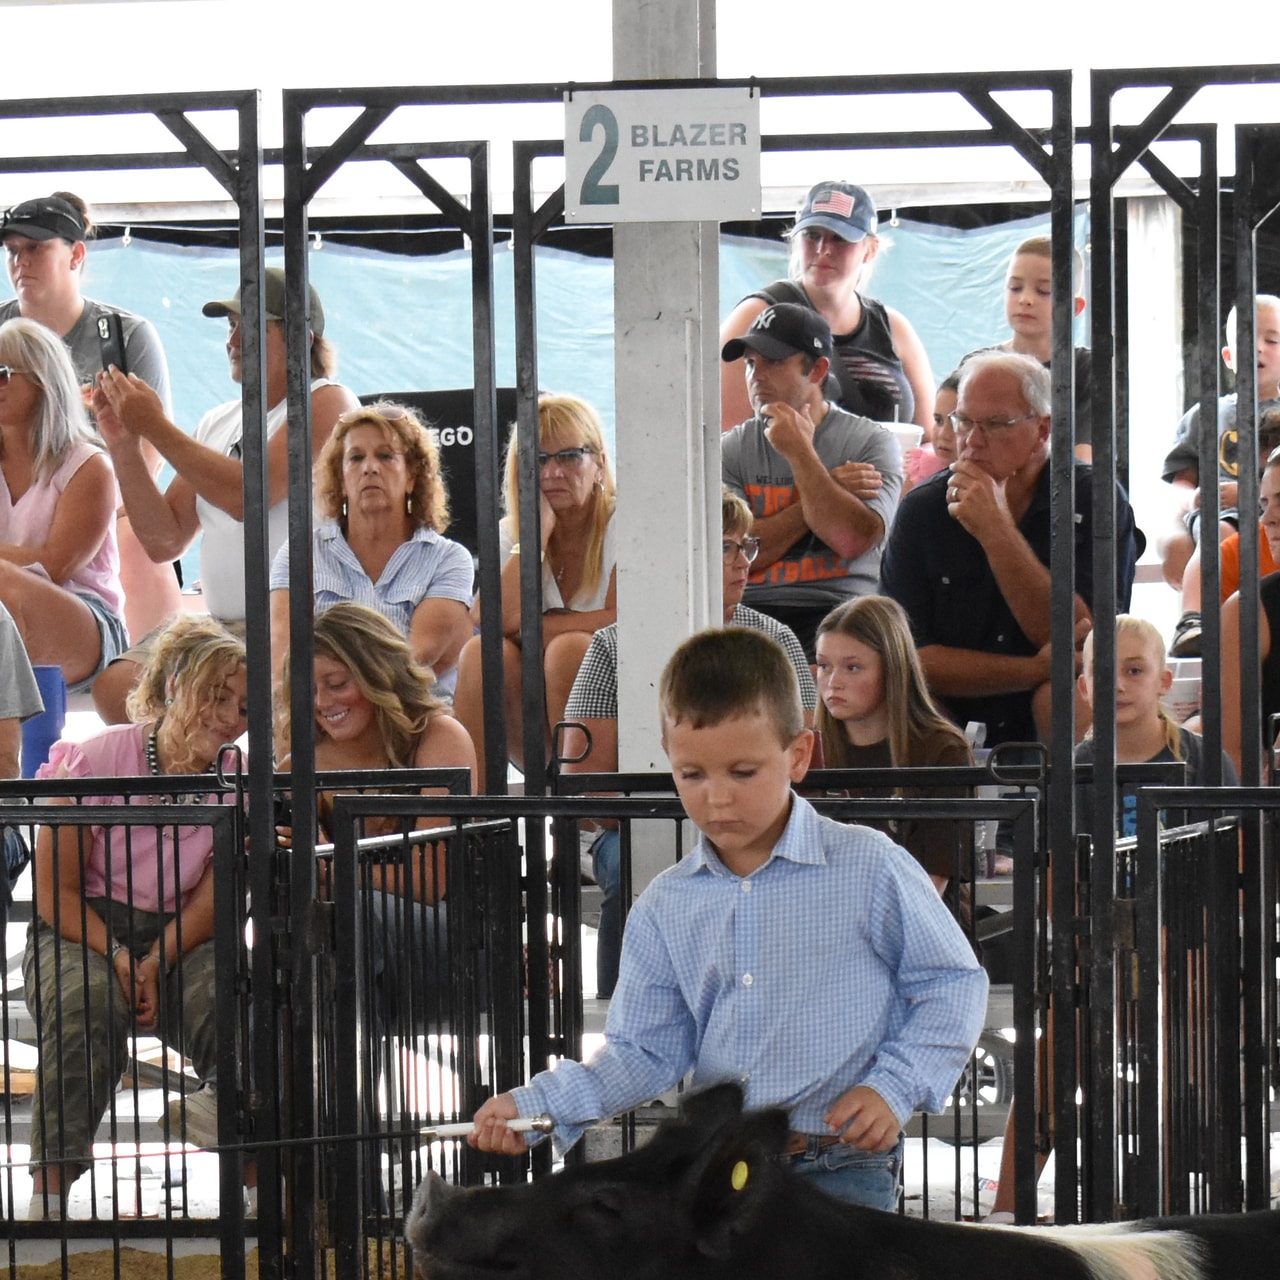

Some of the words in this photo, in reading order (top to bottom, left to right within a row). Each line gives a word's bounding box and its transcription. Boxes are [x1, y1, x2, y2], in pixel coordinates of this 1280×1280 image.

[631, 123, 747, 147] BLAZER
[579, 104, 619, 205] 2
[639, 158, 740, 182] FARMS
